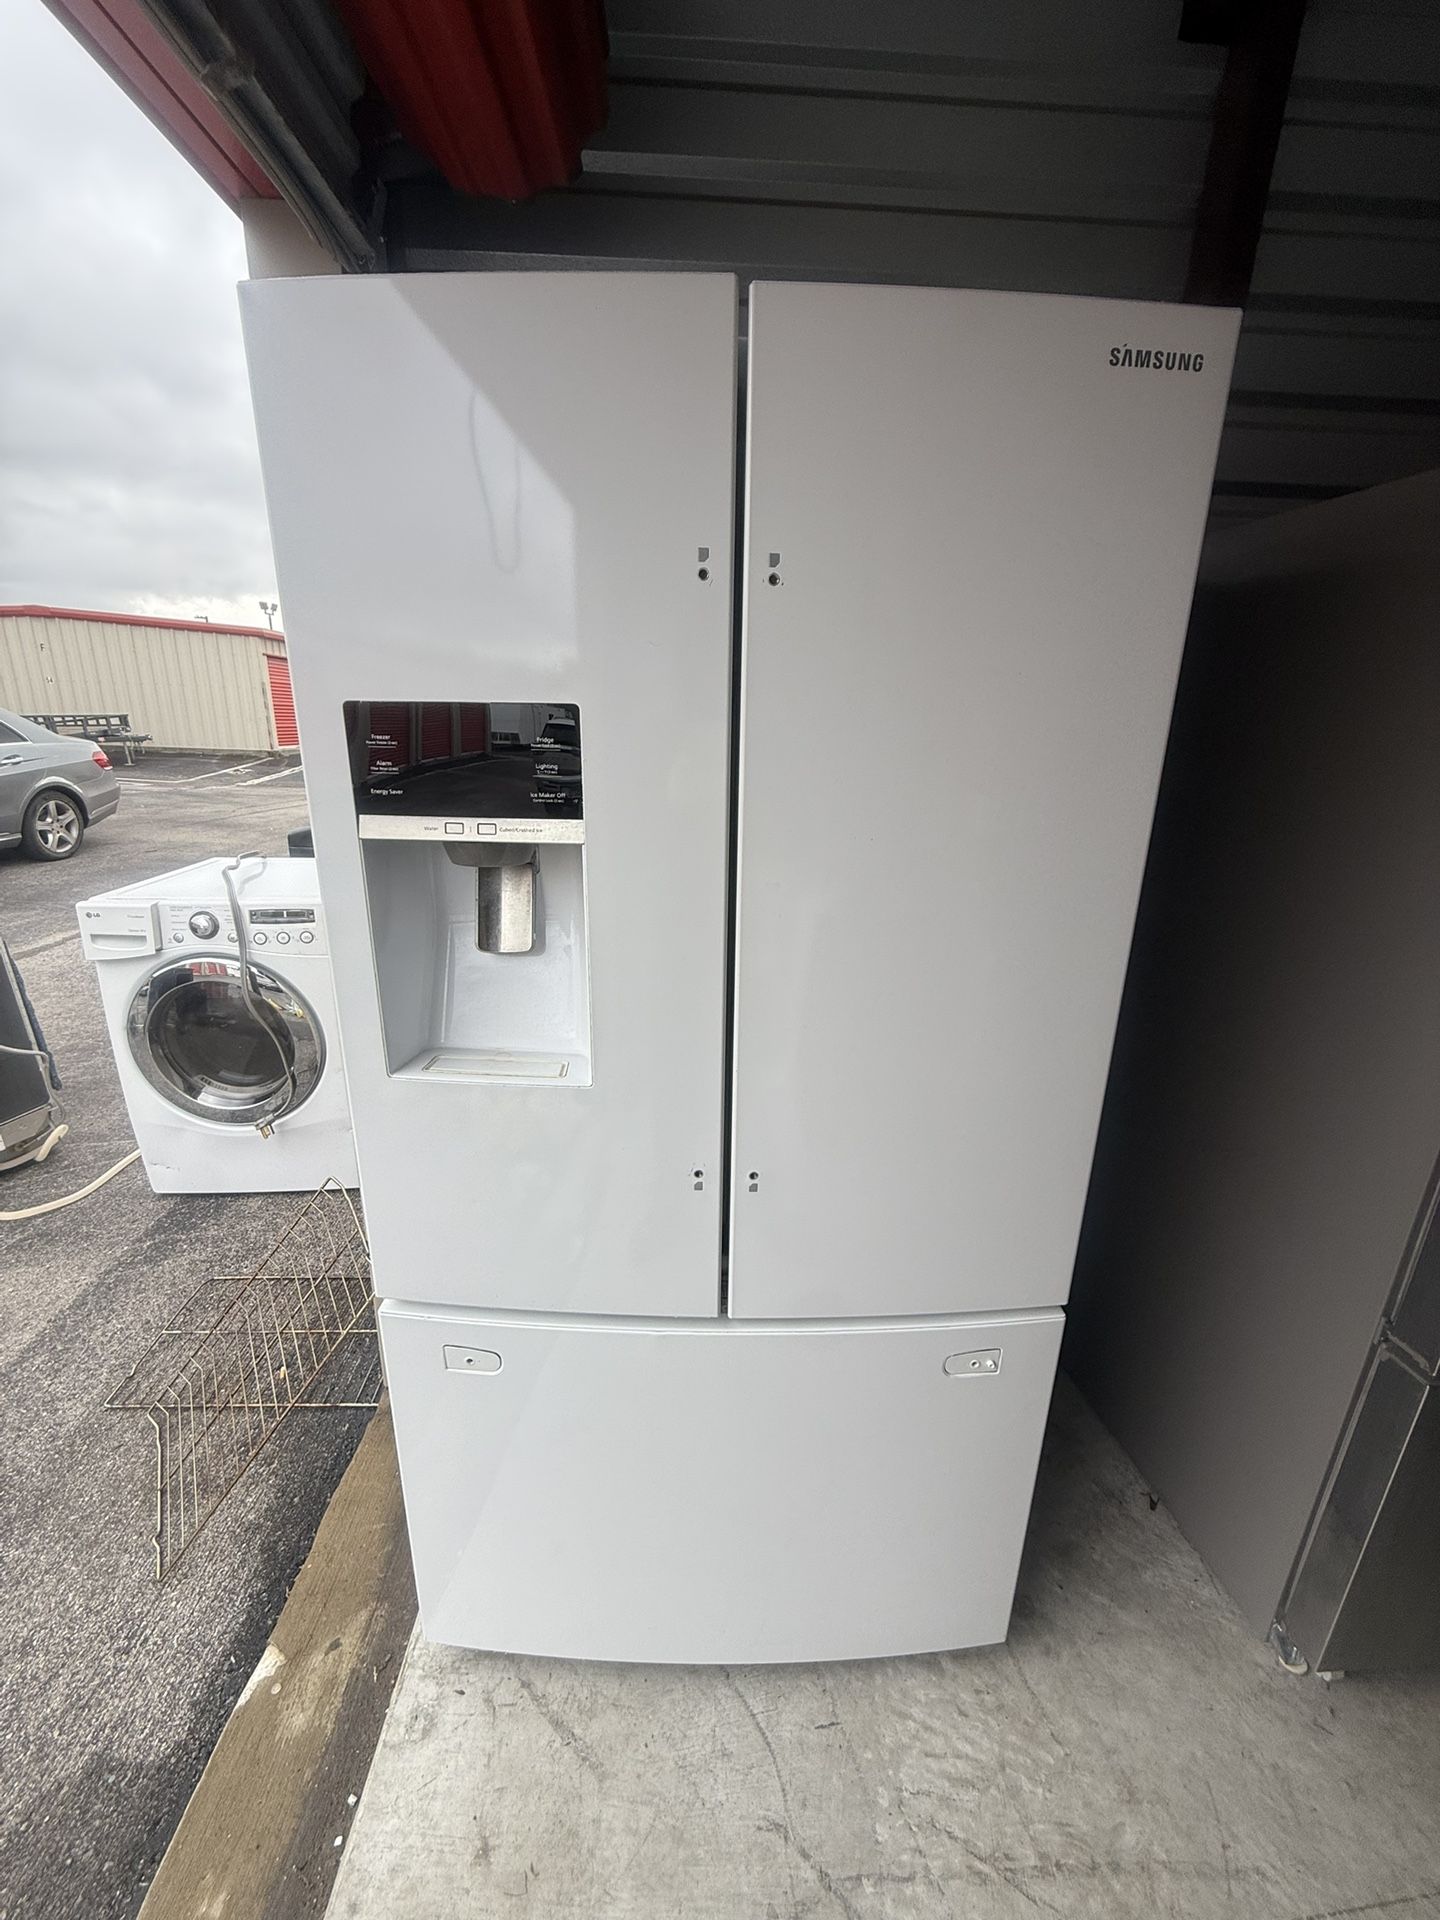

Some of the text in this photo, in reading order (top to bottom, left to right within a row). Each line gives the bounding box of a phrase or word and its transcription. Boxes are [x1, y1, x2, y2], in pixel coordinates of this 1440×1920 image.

[1109, 344, 1204, 372] SAMSUNG
[536, 736, 554, 744] Fridge
[535, 763, 559, 771] Lighting
[370, 788, 389, 796] Energy
